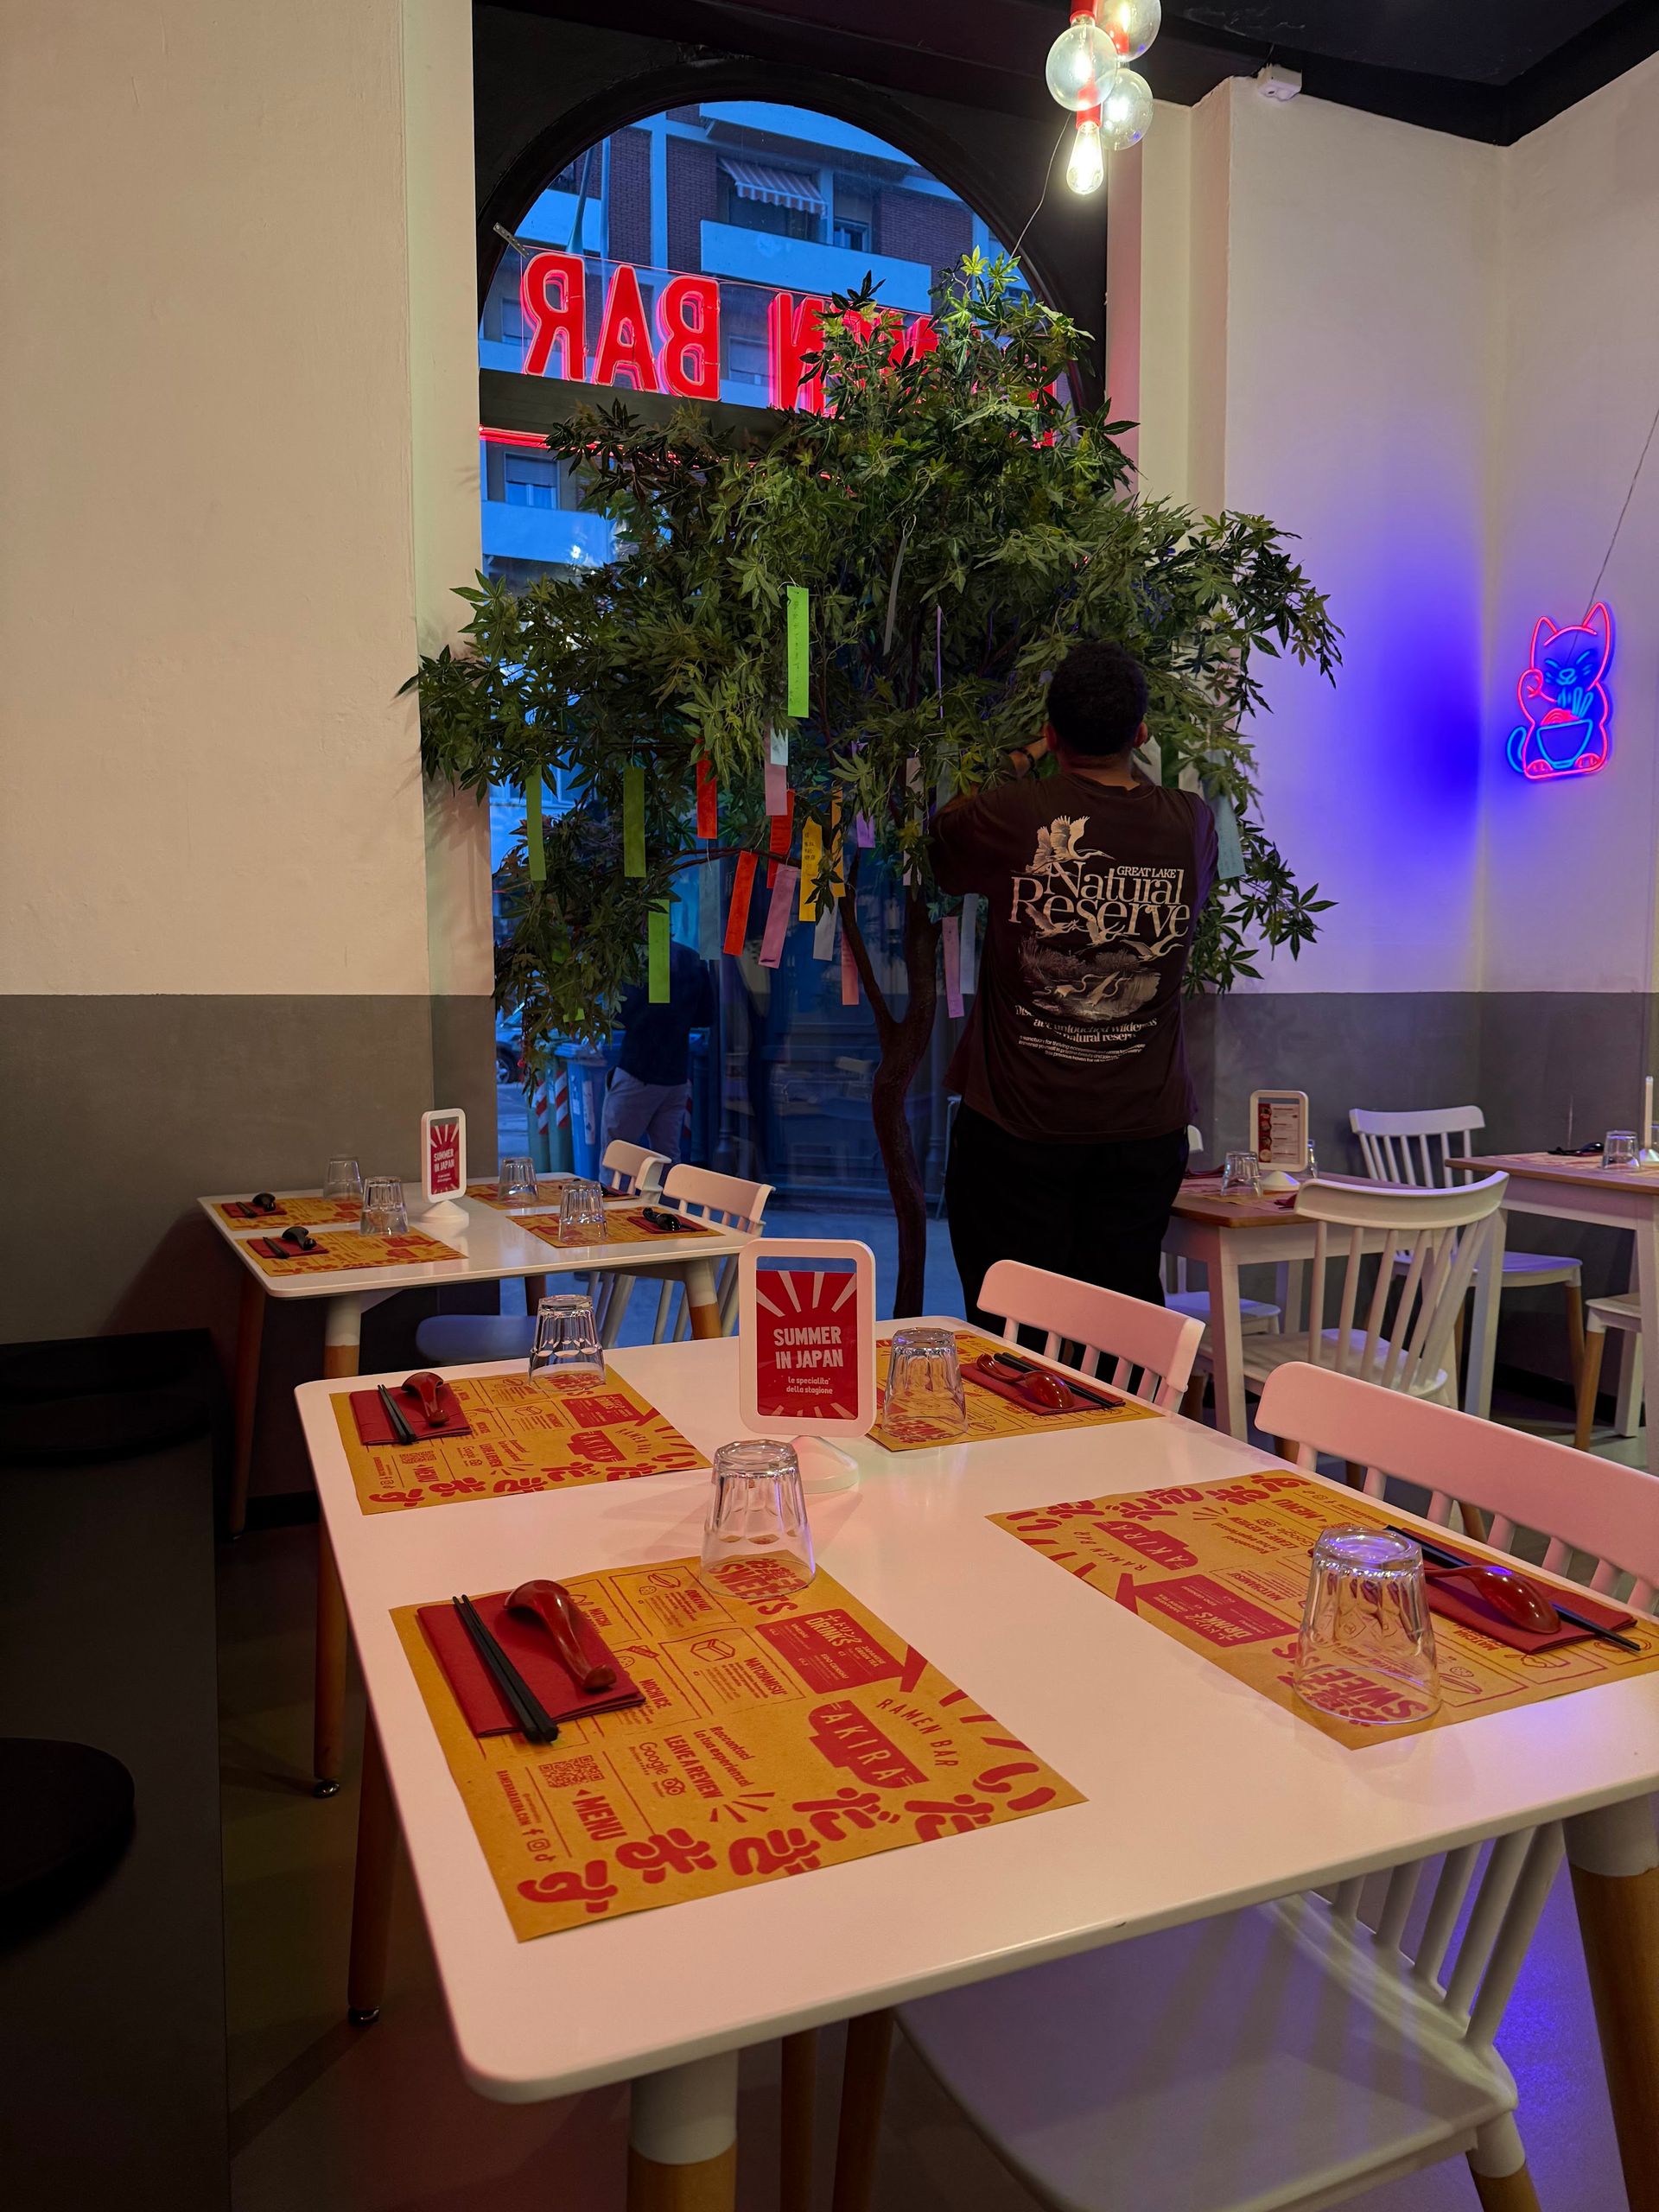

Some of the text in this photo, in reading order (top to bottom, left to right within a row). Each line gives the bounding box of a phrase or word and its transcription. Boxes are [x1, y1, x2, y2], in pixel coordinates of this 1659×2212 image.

[1044, 861, 1185, 906] Natural
[1117, 866, 1176, 879] GREAT LAKE
[1008, 876, 1191, 938] Reserve
[773, 1326, 842, 1346] SUMMER
[775, 1349, 843, 1369] IN JAPAN
[804, 1386, 833, 1395] stagione
[578, 1434, 615, 1459] AKIRA
[1268, 1498, 1325, 1519] MENU
[1073, 1532, 1146, 1570] RAMEN BAR
[1110, 1524, 1189, 1561] AKIRA
[709, 1564, 798, 1614] SWEETS
[804, 1618, 849, 1645] DRINKS
[1196, 1611, 1253, 1637] DRINKS
[638, 1678, 665, 1699] MOCHI
[743, 1657, 788, 1695] MATCHAMISU'
[651, 1696, 673, 1708] ICE
[699, 1737, 715, 1748] tua
[876, 1698, 958, 1764] RAMEN BAR
[639, 1742, 671, 1775] Google
[818, 1713, 905, 1781] AKIRA
[663, 1734, 696, 1760] LEAVE
[683, 1765, 724, 1798] REVIEW
[571, 1796, 626, 1841] MENU
